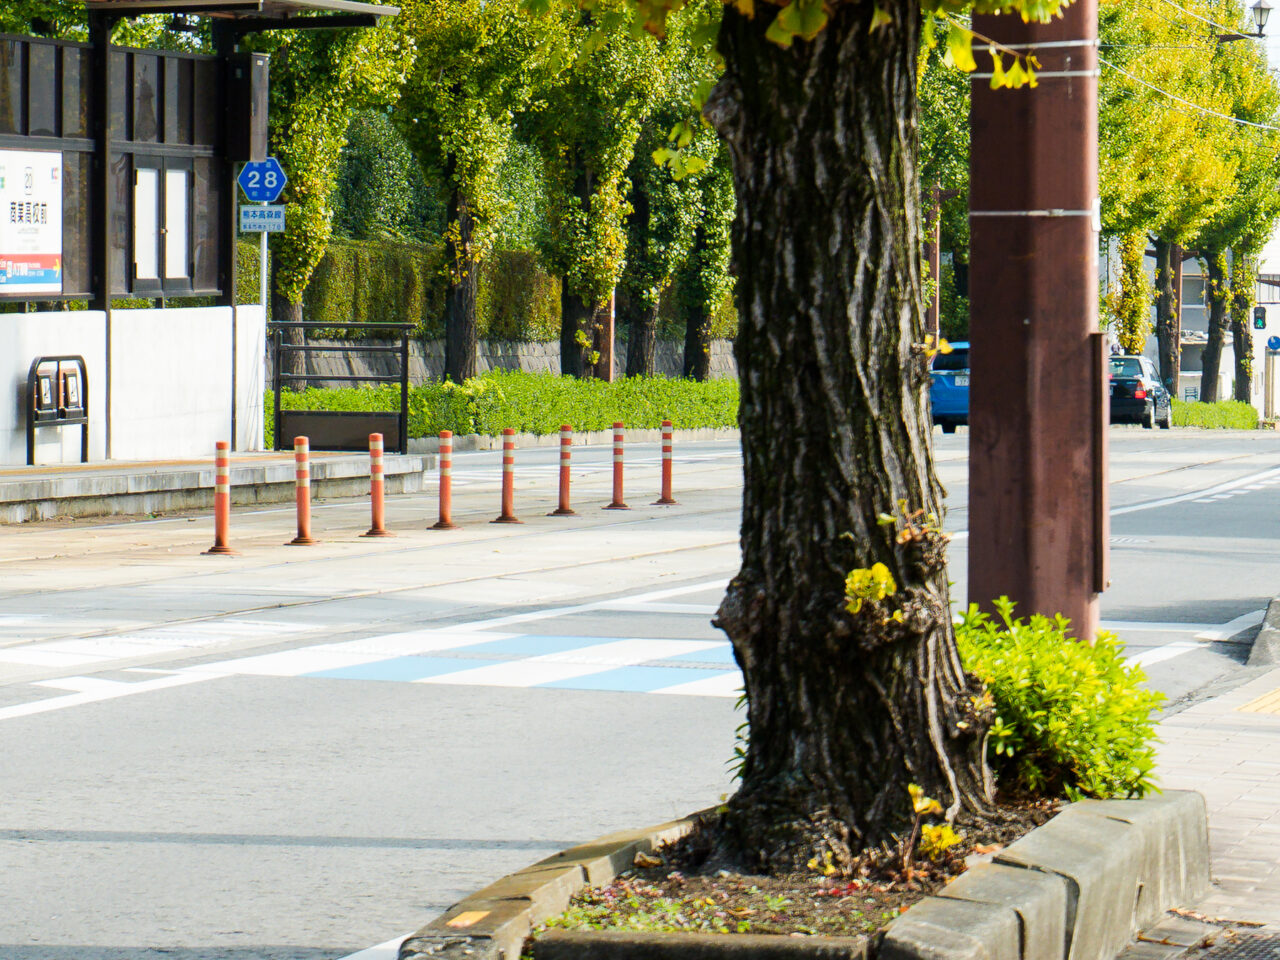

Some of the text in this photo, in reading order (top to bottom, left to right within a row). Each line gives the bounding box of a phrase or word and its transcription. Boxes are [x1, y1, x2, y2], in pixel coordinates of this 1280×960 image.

[24, 173, 33, 189] 20
[247, 171, 277, 188] 28
[10, 201, 47, 225] 商業高校前
